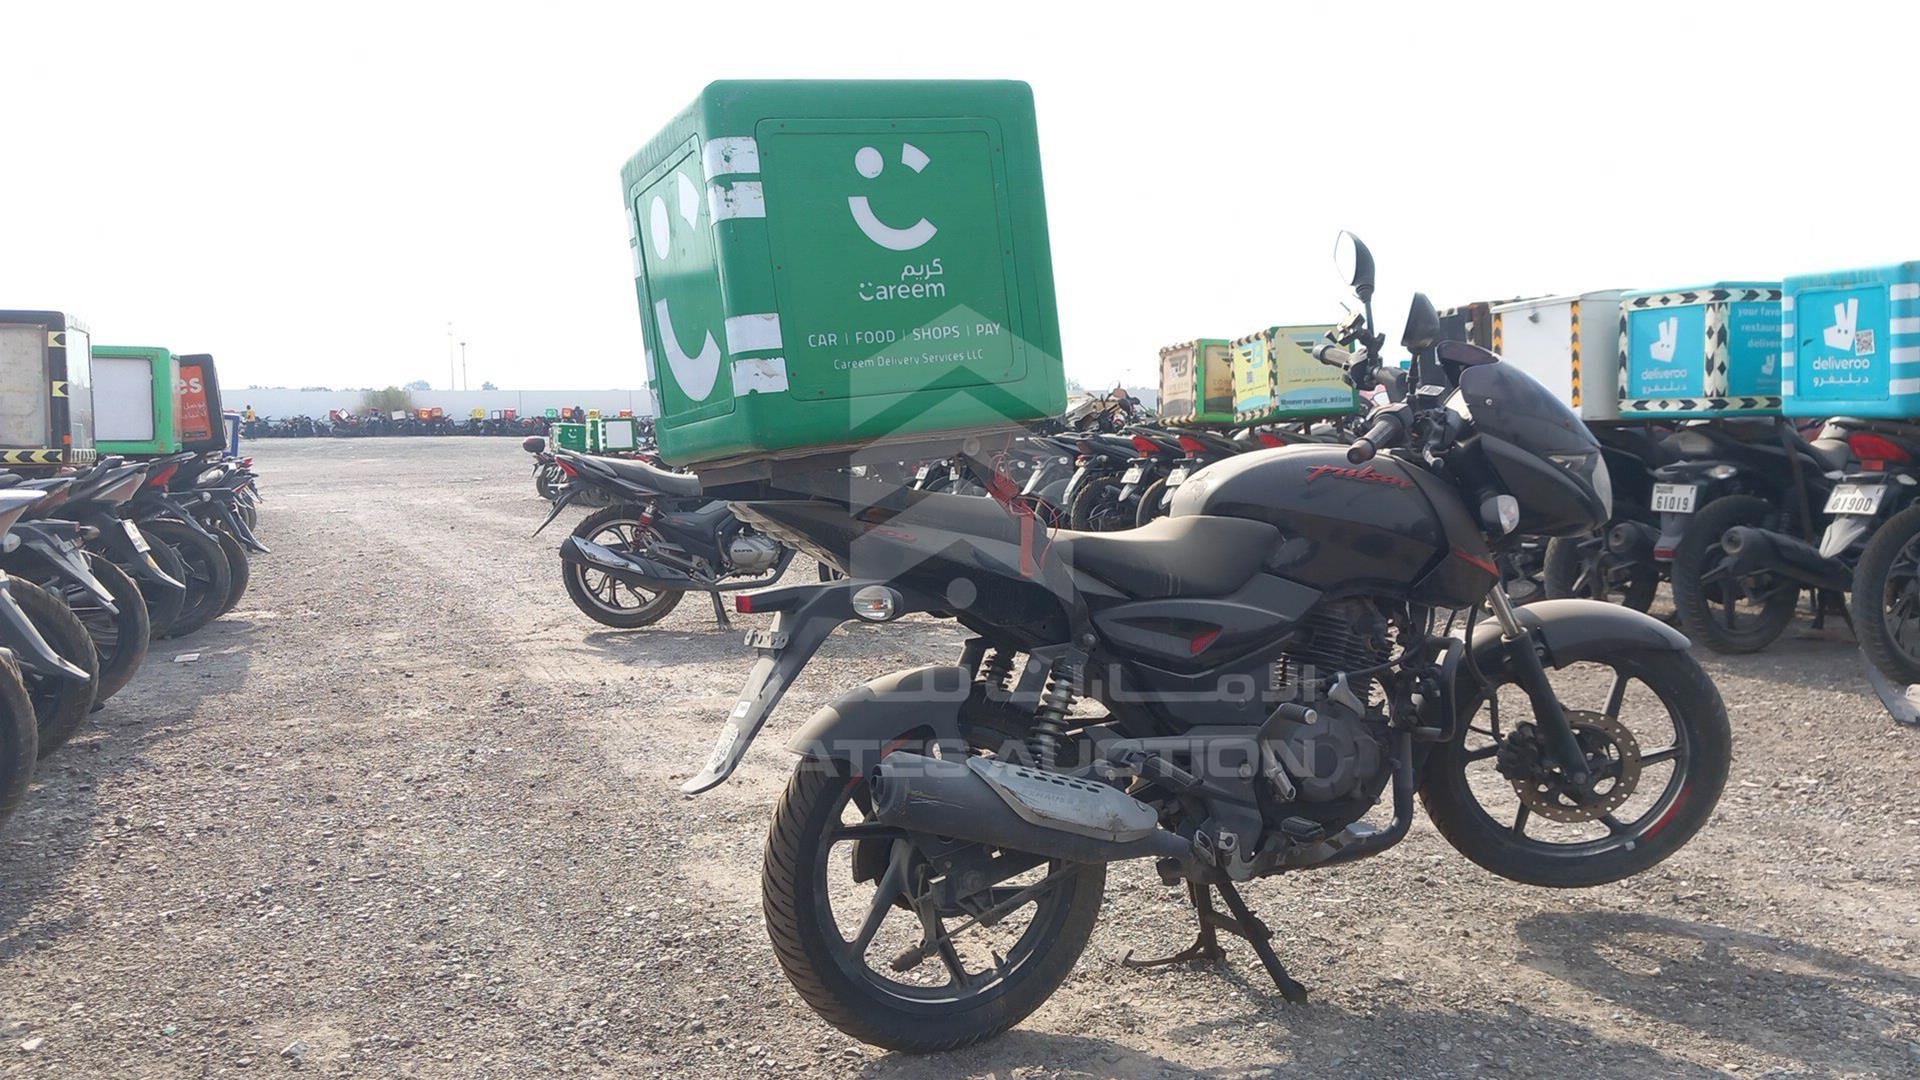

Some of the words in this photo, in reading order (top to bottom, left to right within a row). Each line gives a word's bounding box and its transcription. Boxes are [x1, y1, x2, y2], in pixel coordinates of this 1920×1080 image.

[900, 257, 944, 281] كريم
[808, 333, 838, 348] CAR
[855, 329, 896, 344] FOOD
[912, 324, 961, 341] SHOPS
[976, 322, 1001, 337] PAY
[834, 359, 875, 370] Careem
[877, 353, 921, 367] Delivery
[922, 350, 965, 364] Services
[966, 348, 984, 361] LLC
[1813, 356, 1870, 370] deliveroo
[1641, 367, 1688, 380] deliveroo
[1655, 495, 1690, 511] 61019
